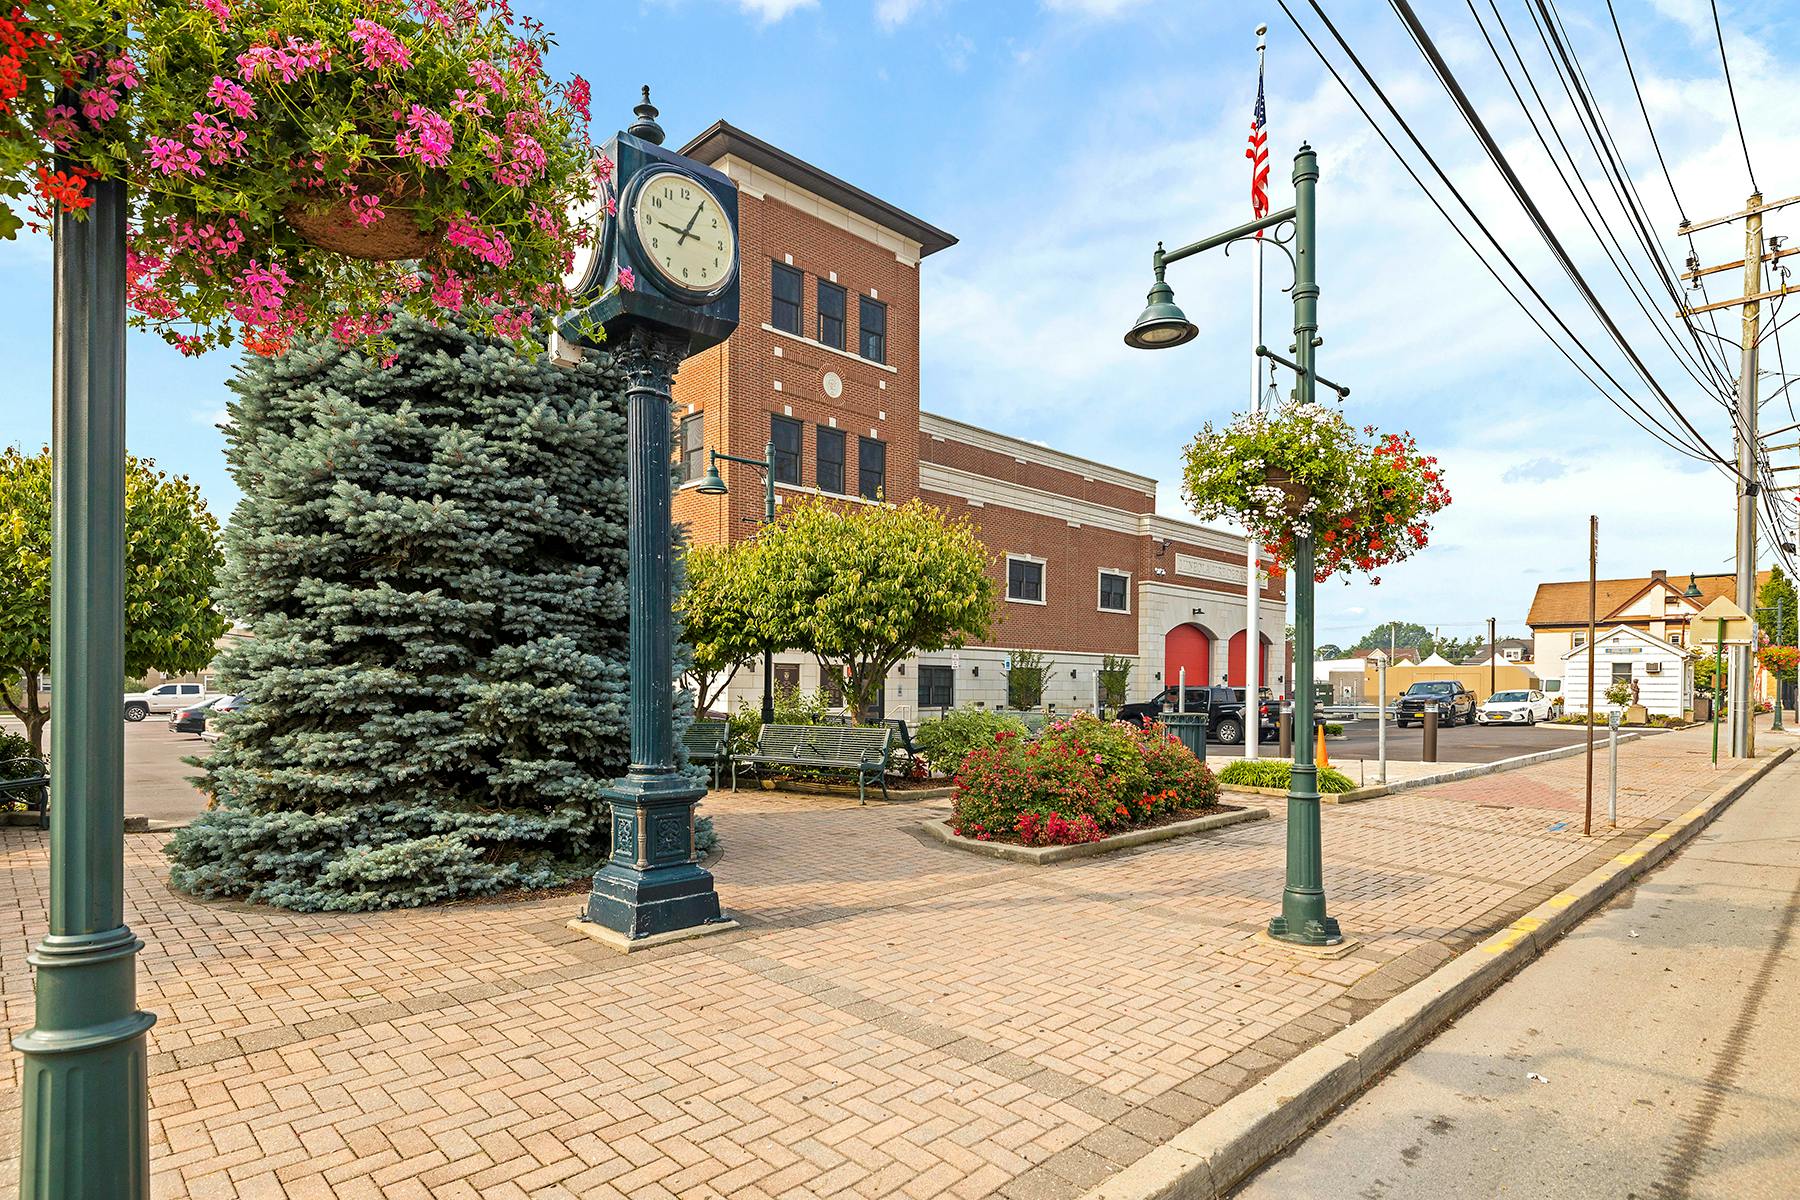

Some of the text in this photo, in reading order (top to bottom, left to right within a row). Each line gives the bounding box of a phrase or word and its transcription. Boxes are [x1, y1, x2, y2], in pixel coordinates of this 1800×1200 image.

[664, 188, 673, 200] 11
[680, 188, 690, 200] 12
[652, 196, 662, 208] 10
[646, 214, 652, 224] 9
[712, 218, 717, 228] 2
[652, 238, 658, 248] 8
[718, 240, 722, 251] 3
[666, 256, 671, 268] 7
[713, 258, 718, 268] 4
[683, 268, 688, 278] 6
[702, 268, 706, 278] 5
